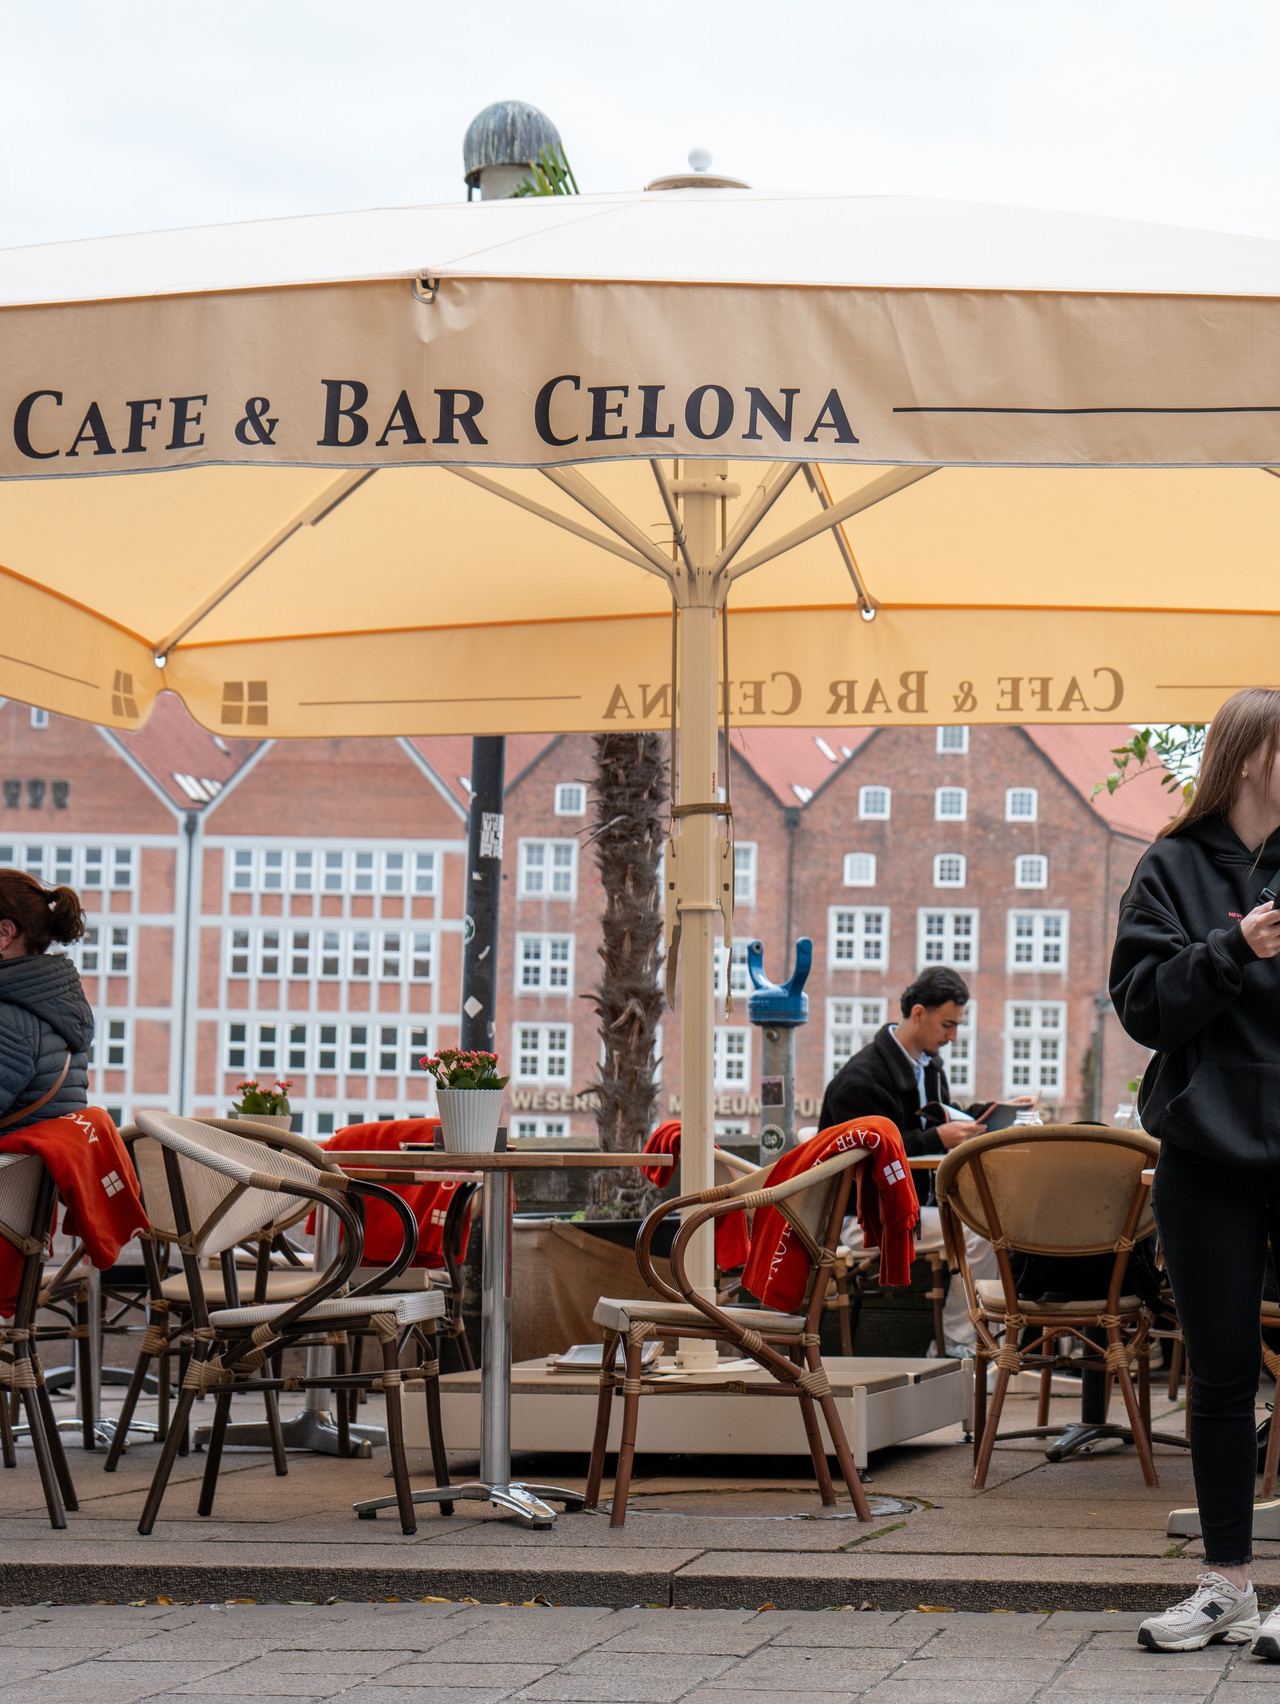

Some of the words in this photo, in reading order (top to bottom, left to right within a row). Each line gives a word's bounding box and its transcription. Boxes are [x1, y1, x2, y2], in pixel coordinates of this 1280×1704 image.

[12, 388, 209, 461] CAFE
[233, 395, 281, 447] &
[316, 378, 490, 448] BAR
[534, 373, 861, 448] CELONA
